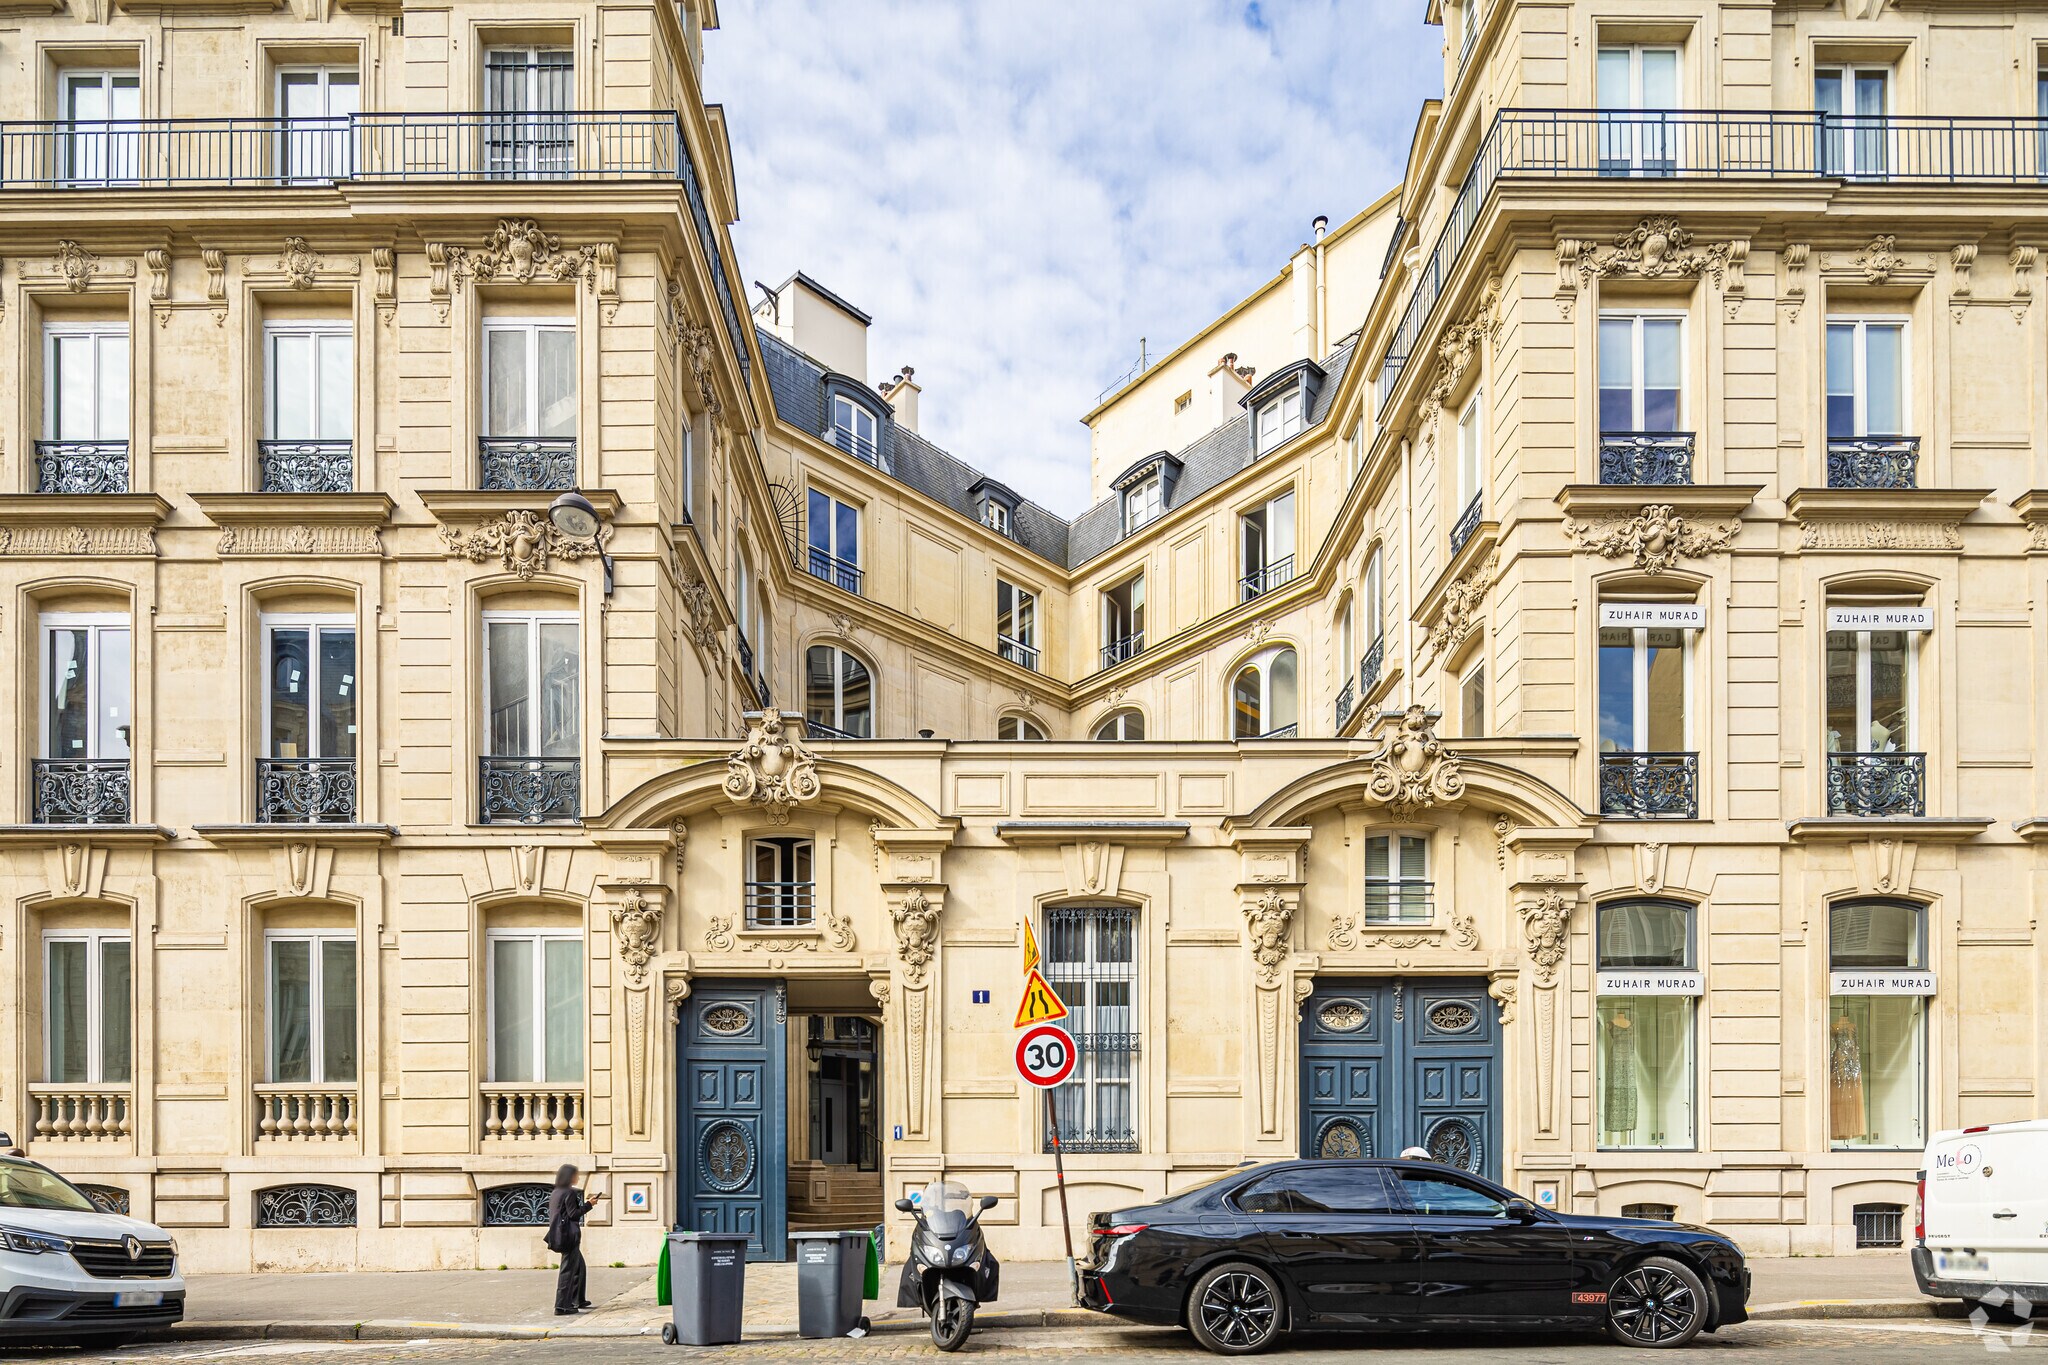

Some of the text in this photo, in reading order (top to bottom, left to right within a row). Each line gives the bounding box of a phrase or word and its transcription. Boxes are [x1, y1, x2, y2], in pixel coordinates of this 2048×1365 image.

[1609, 611, 1698, 620] ZUHAIR MURAD
[1836, 614, 1925, 623] ZUHAIR MURAD
[1601, 632, 1628, 641] HAIR
[1607, 979, 1696, 988] ZUHAIR MURAD
[1841, 979, 1931, 988] ZUHAIR MURAD
[1027, 1042, 1064, 1071] 30
[1577, 1294, 1606, 1302] 43977
